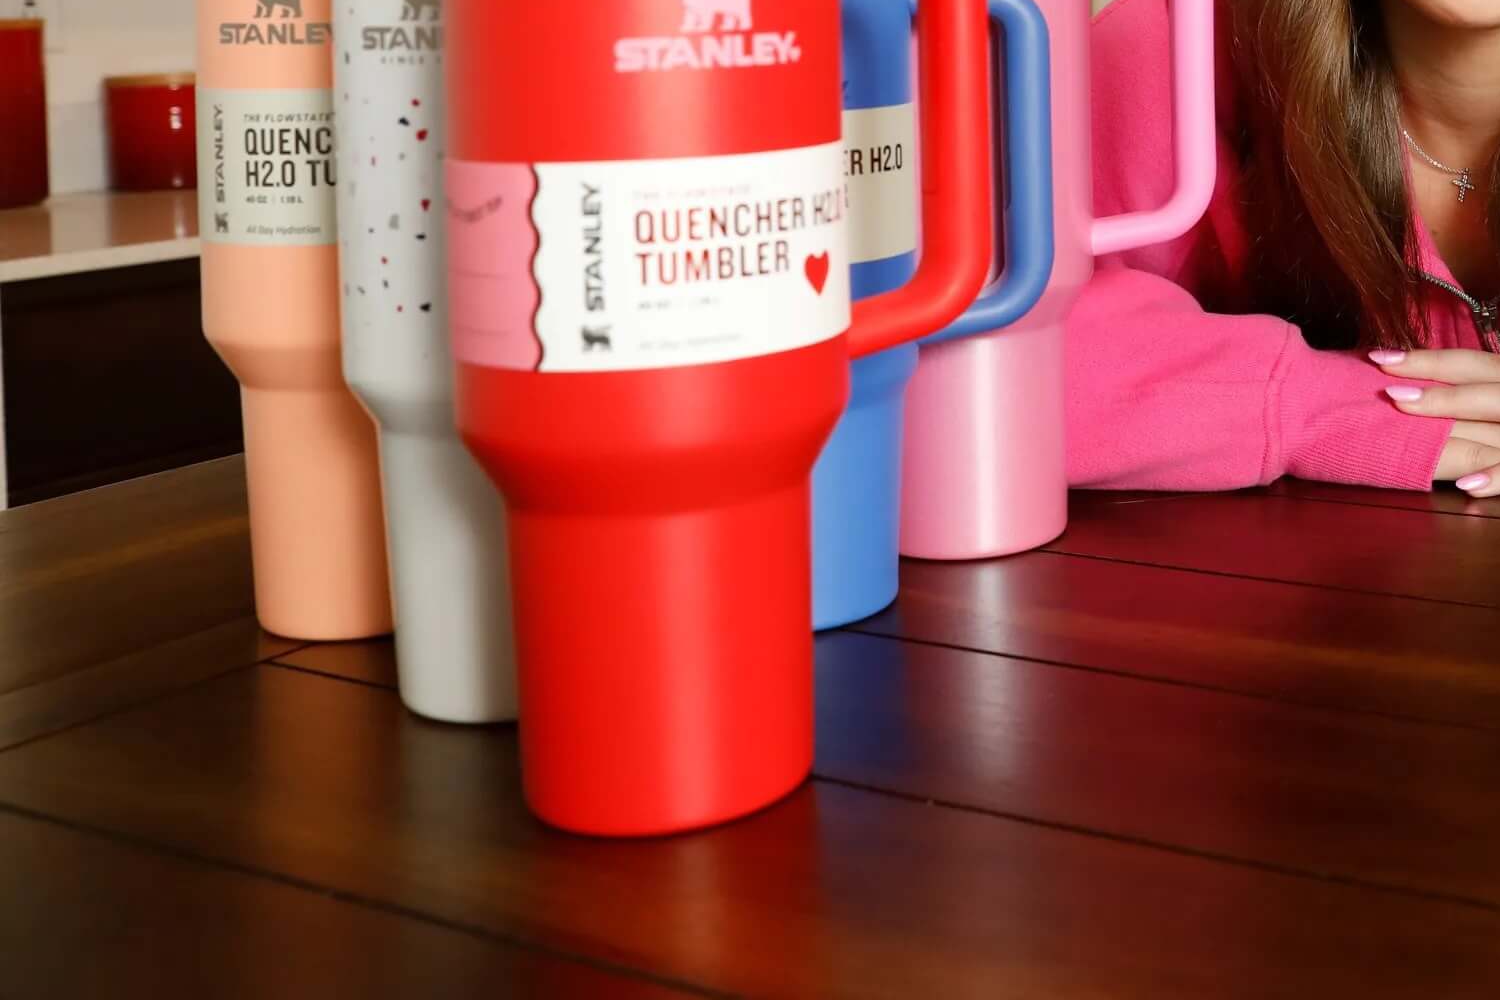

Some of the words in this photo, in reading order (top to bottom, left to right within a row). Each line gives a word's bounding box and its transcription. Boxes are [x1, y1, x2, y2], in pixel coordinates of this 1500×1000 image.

[613, 31, 797, 73] STANLEY
[213, 104, 226, 203] STANLEY
[635, 198, 805, 244] QUENCHER
[580, 181, 605, 312] STANLEY
[635, 240, 790, 286] TUMBLER
